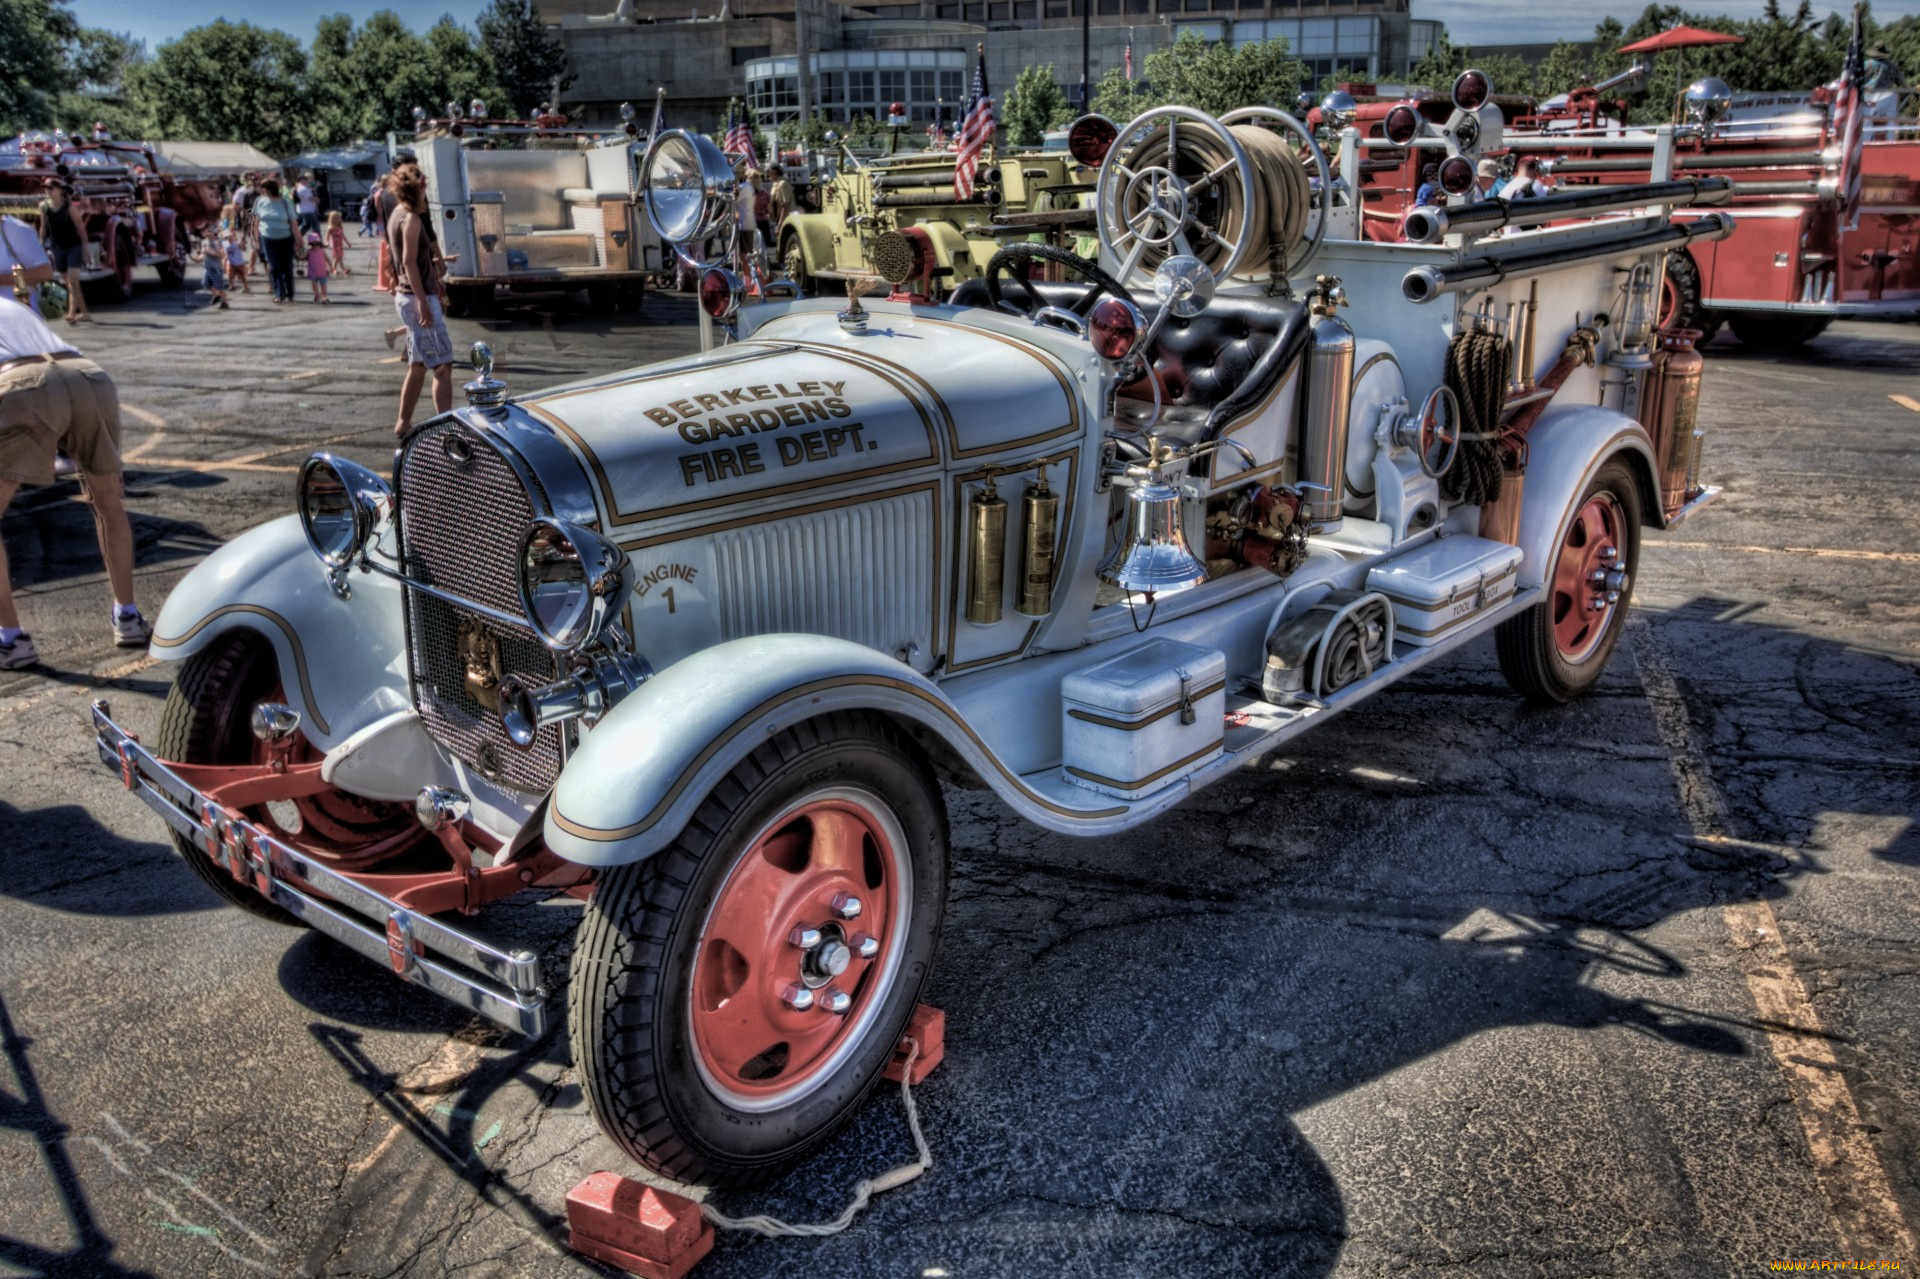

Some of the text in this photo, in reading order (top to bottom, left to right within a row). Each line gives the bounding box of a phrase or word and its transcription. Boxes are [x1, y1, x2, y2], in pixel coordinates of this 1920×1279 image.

[643, 381, 846, 427] BERKELEY
[677, 397, 852, 445] GARDENS
[678, 422, 878, 487] FIRE DEPT.
[633, 563, 698, 598] ENGINE
[661, 586, 676, 614] 1
[1453, 601, 1470, 617] TOOL
